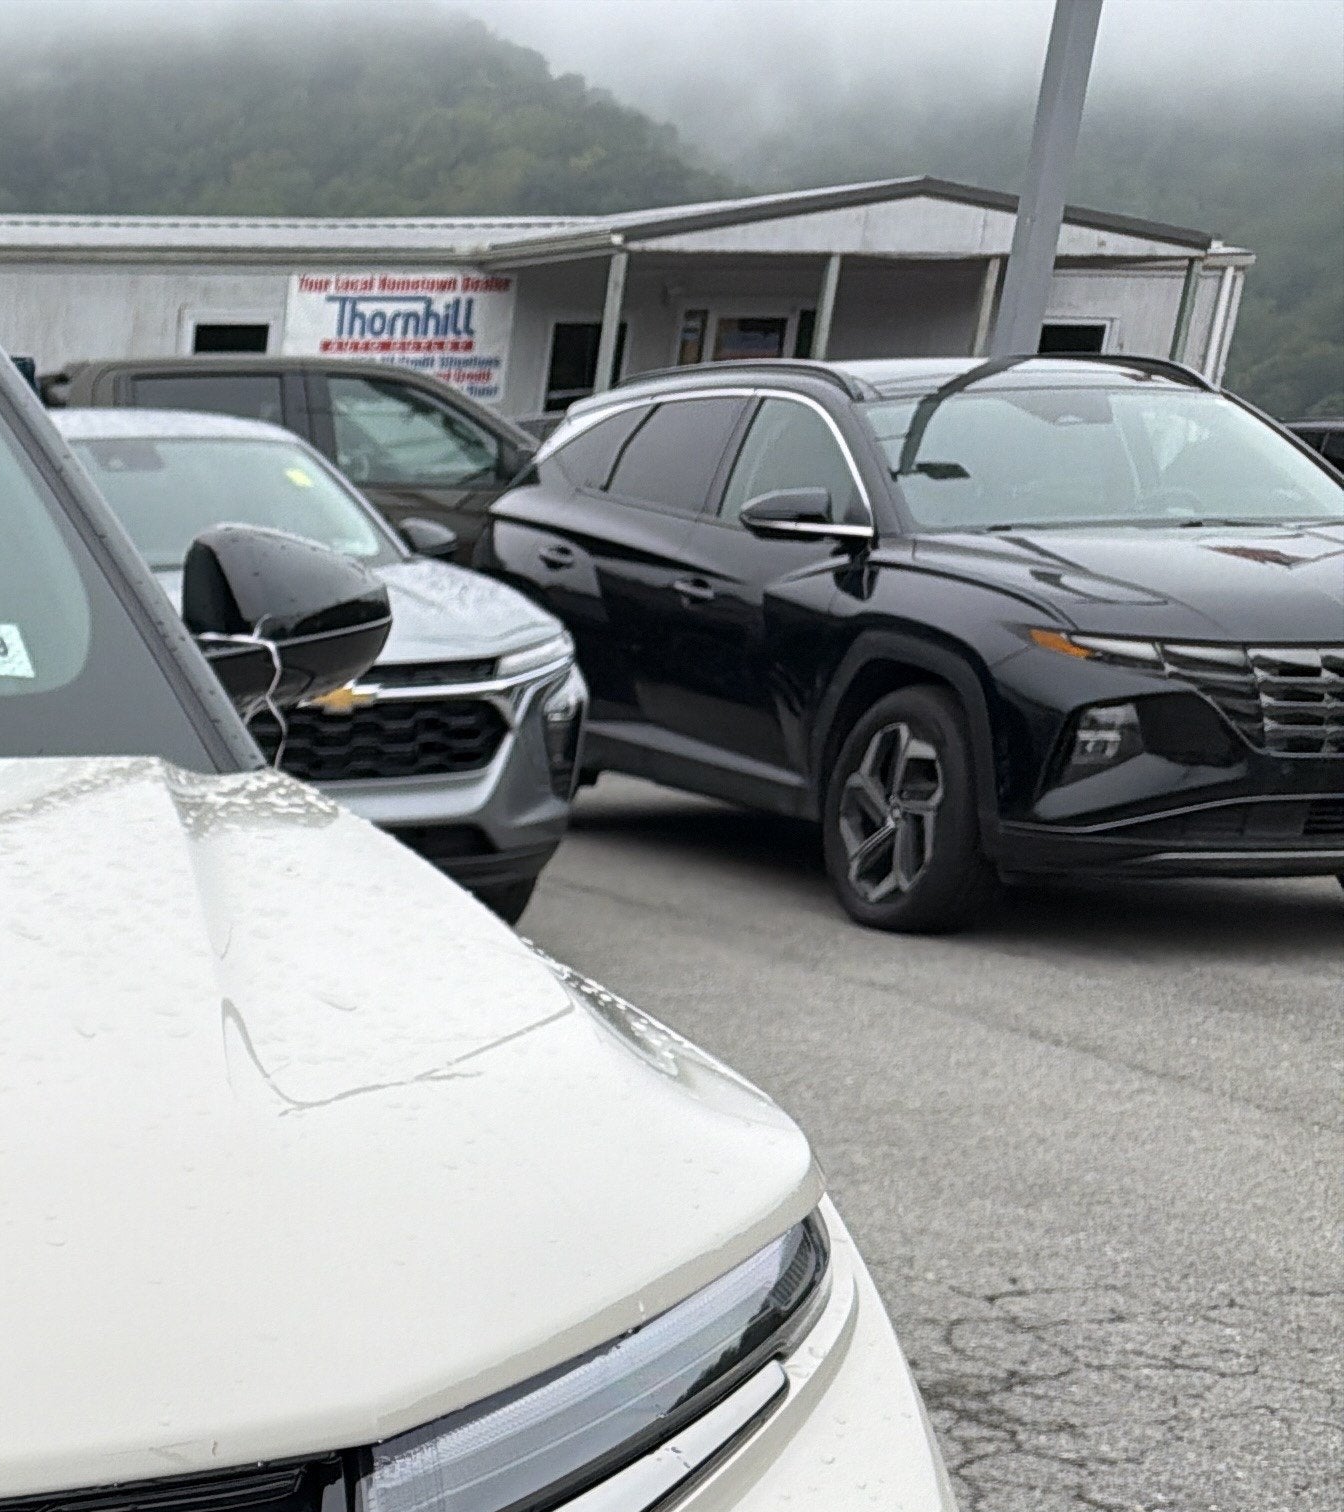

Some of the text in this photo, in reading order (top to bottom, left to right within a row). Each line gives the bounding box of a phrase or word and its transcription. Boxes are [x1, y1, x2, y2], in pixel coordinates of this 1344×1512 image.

[334, 275, 375, 293] Local
[378, 274, 457, 293] Hometown
[461, 277, 511, 294] Dealer
[325, 295, 474, 336] Thornhill
